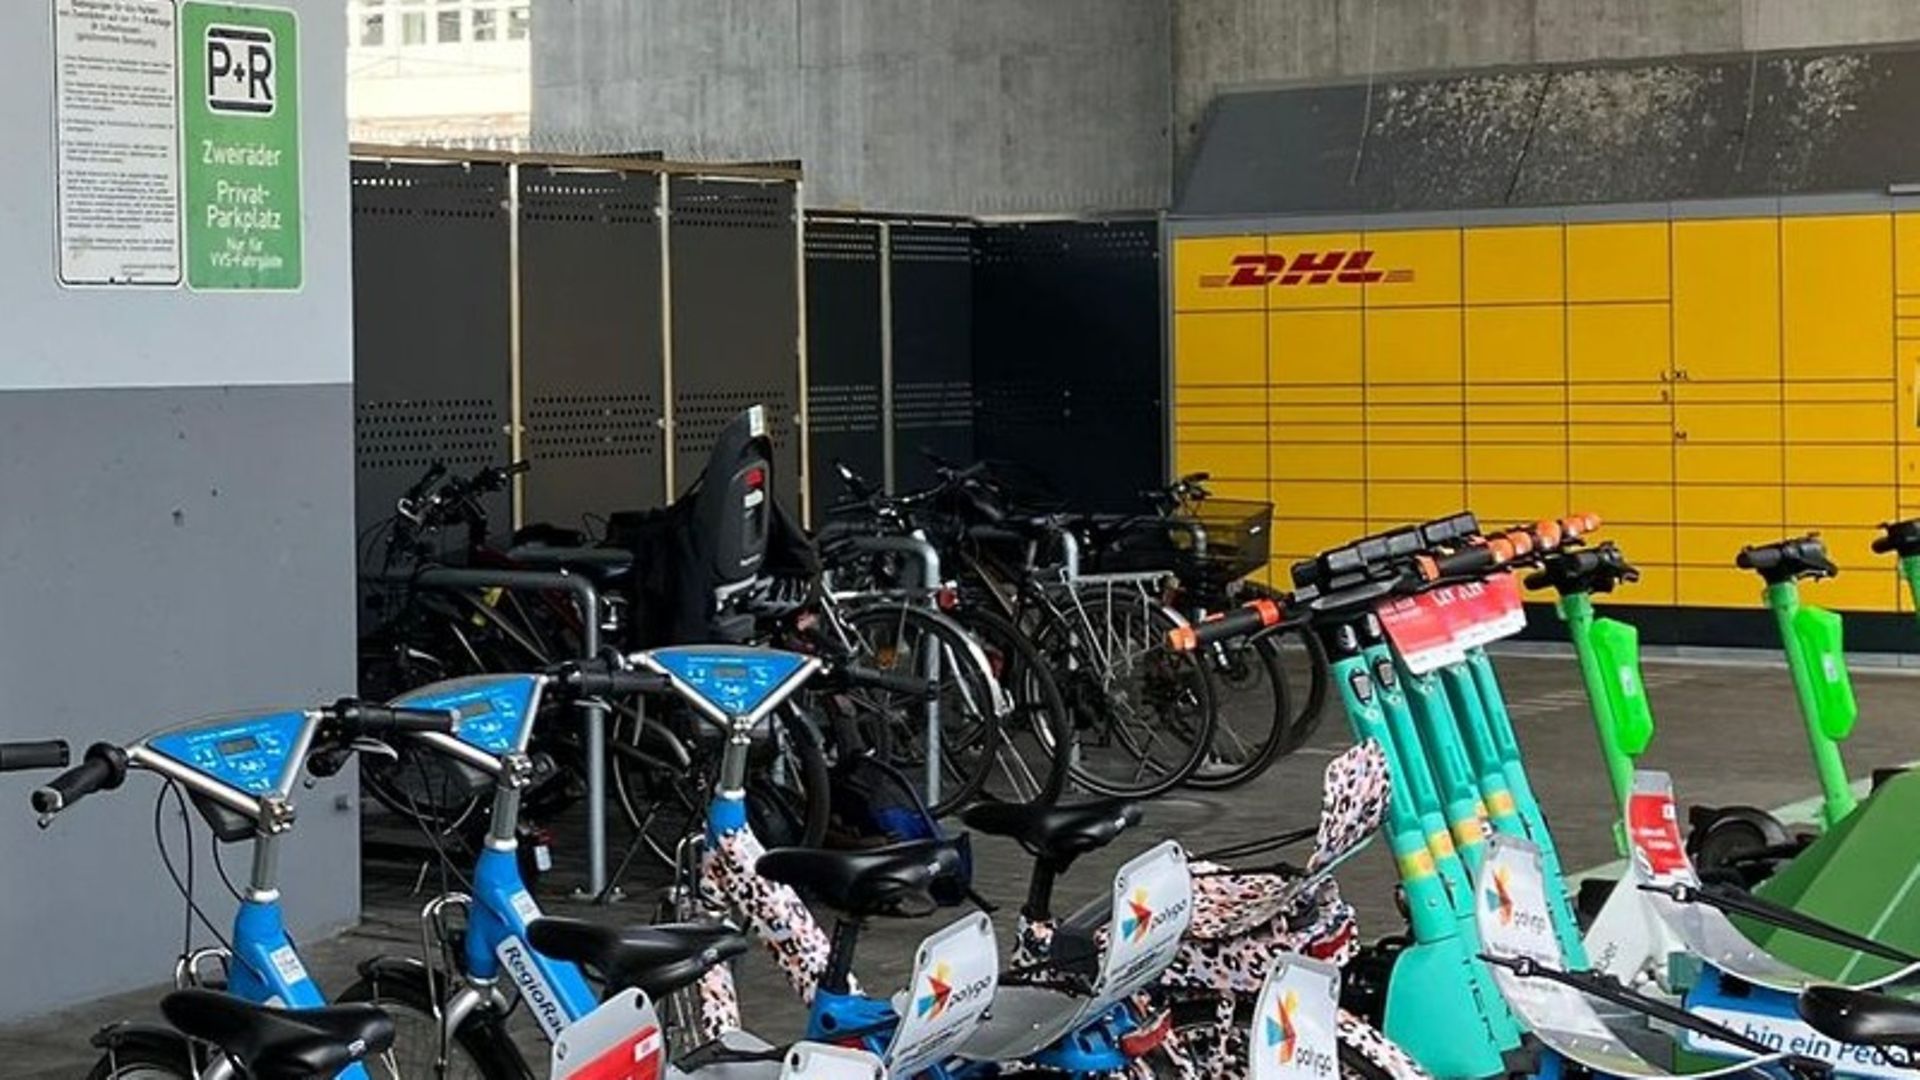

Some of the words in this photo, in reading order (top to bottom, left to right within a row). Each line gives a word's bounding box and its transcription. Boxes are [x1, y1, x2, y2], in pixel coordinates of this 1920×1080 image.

[207, 41, 273, 100] P+R
[202, 139, 282, 166] Zweiräder
[217, 180, 270, 205] Privat-
[207, 204, 281, 233] Parkplatz
[1228, 250, 1384, 287] DHL
[1150, 899, 1187, 931] polygo
[948, 975, 992, 1010] polygo
[1296, 1046, 1332, 1078] polygo
[1790, 1033, 1832, 1060] ein
